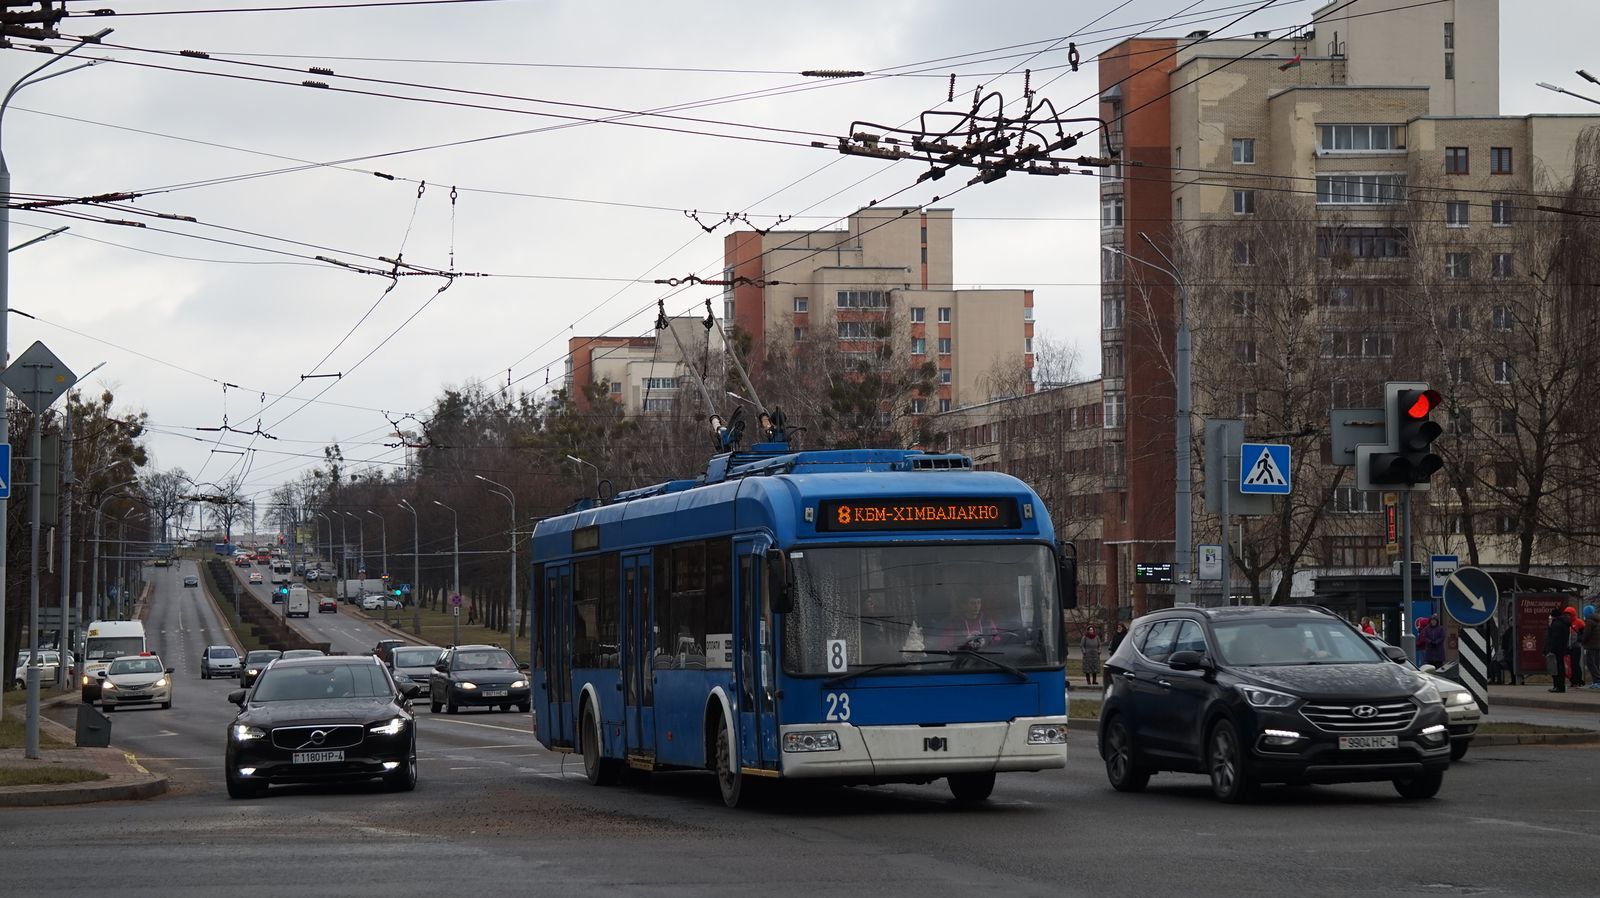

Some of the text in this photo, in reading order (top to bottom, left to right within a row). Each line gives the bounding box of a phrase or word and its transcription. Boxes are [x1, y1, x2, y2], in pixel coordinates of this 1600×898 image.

[838, 505, 1000, 525] 8 КБМ-ХІМВАЛАКНО
[831, 641, 843, 670] 8
[826, 692, 851, 721] 23
